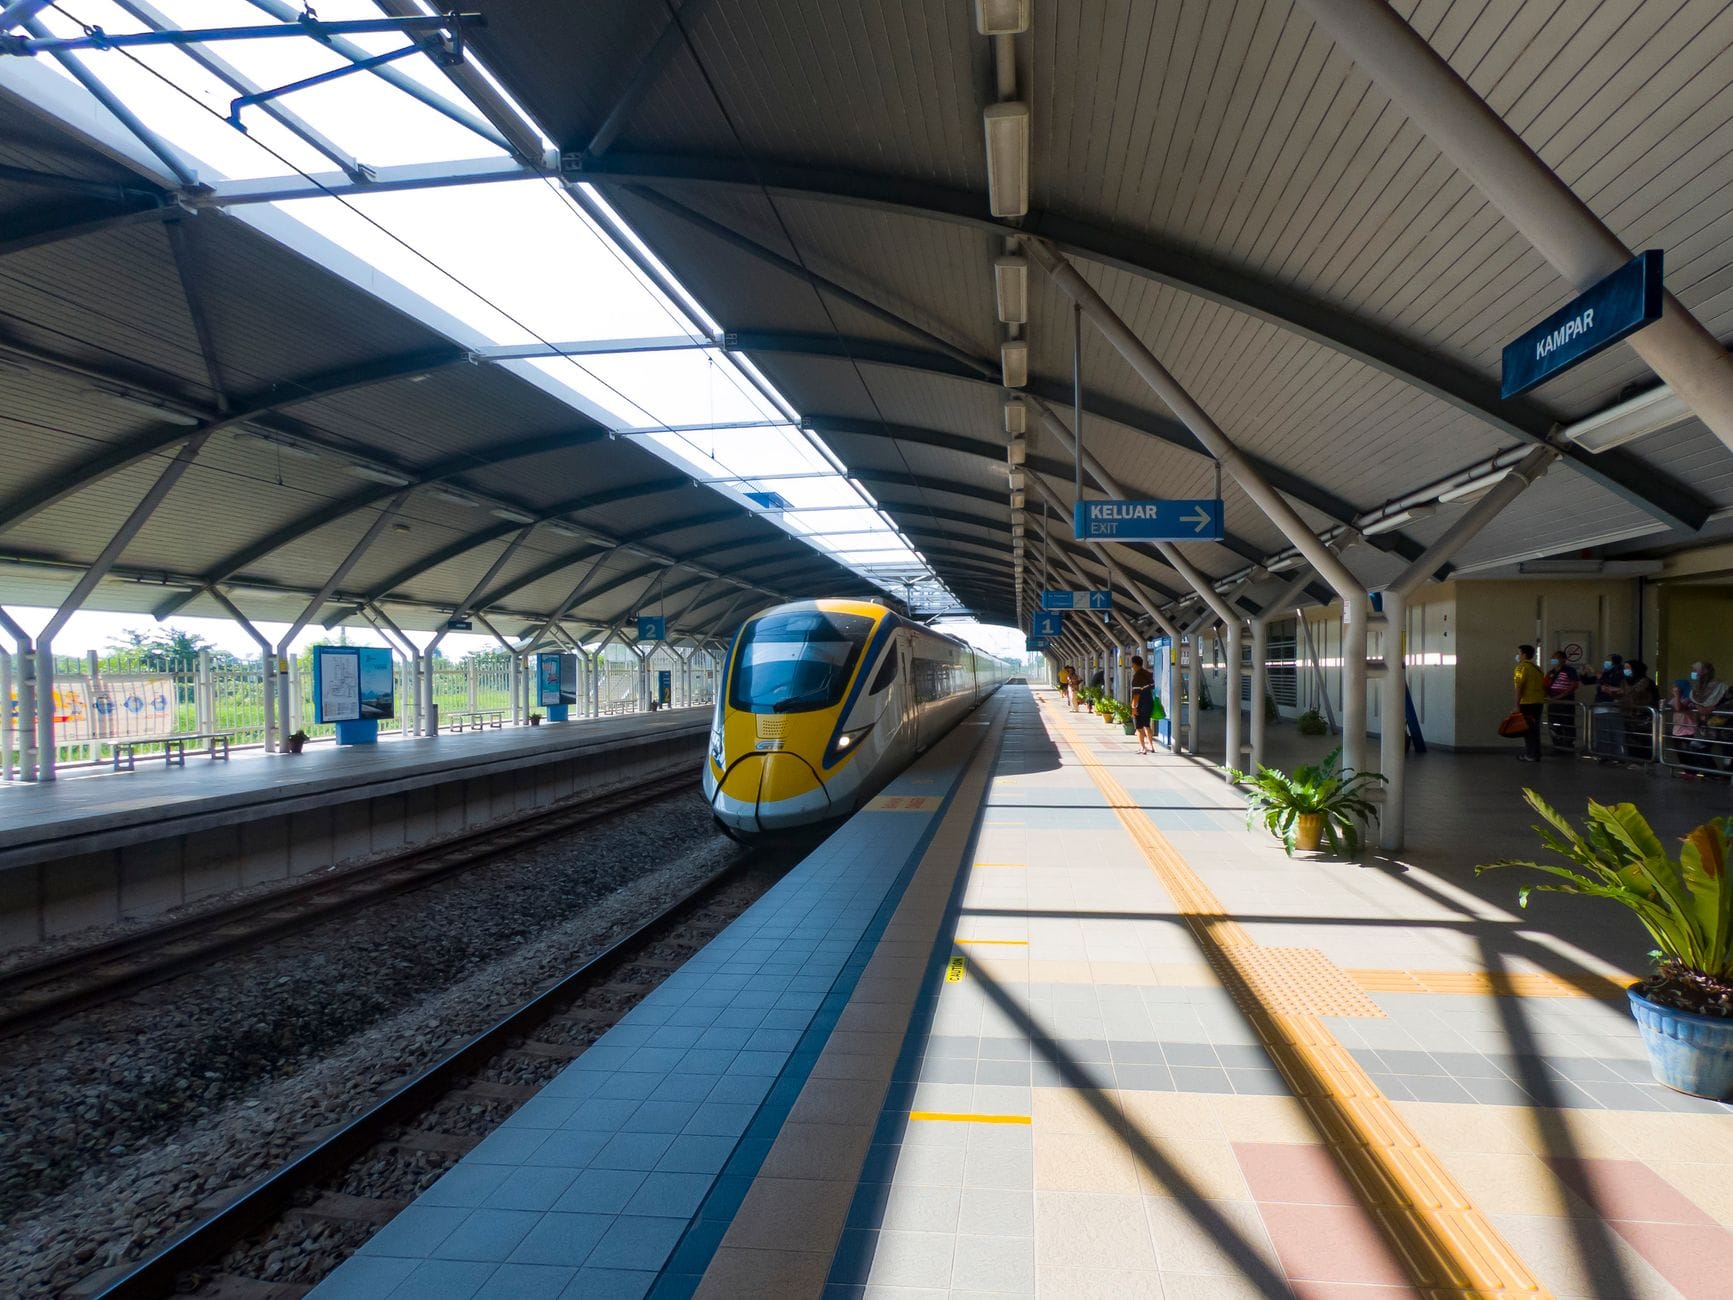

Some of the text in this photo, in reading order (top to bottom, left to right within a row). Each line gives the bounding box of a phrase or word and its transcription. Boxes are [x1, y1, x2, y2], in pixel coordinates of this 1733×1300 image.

[1536, 308, 1594, 360] KAMPAR
[1091, 505, 1157, 519] KELUAR
[1091, 522, 1119, 534] EXIT
[646, 624, 656, 638] 2
[1042, 618, 1054, 634] 1
[949, 957, 963, 981] CAUTION
